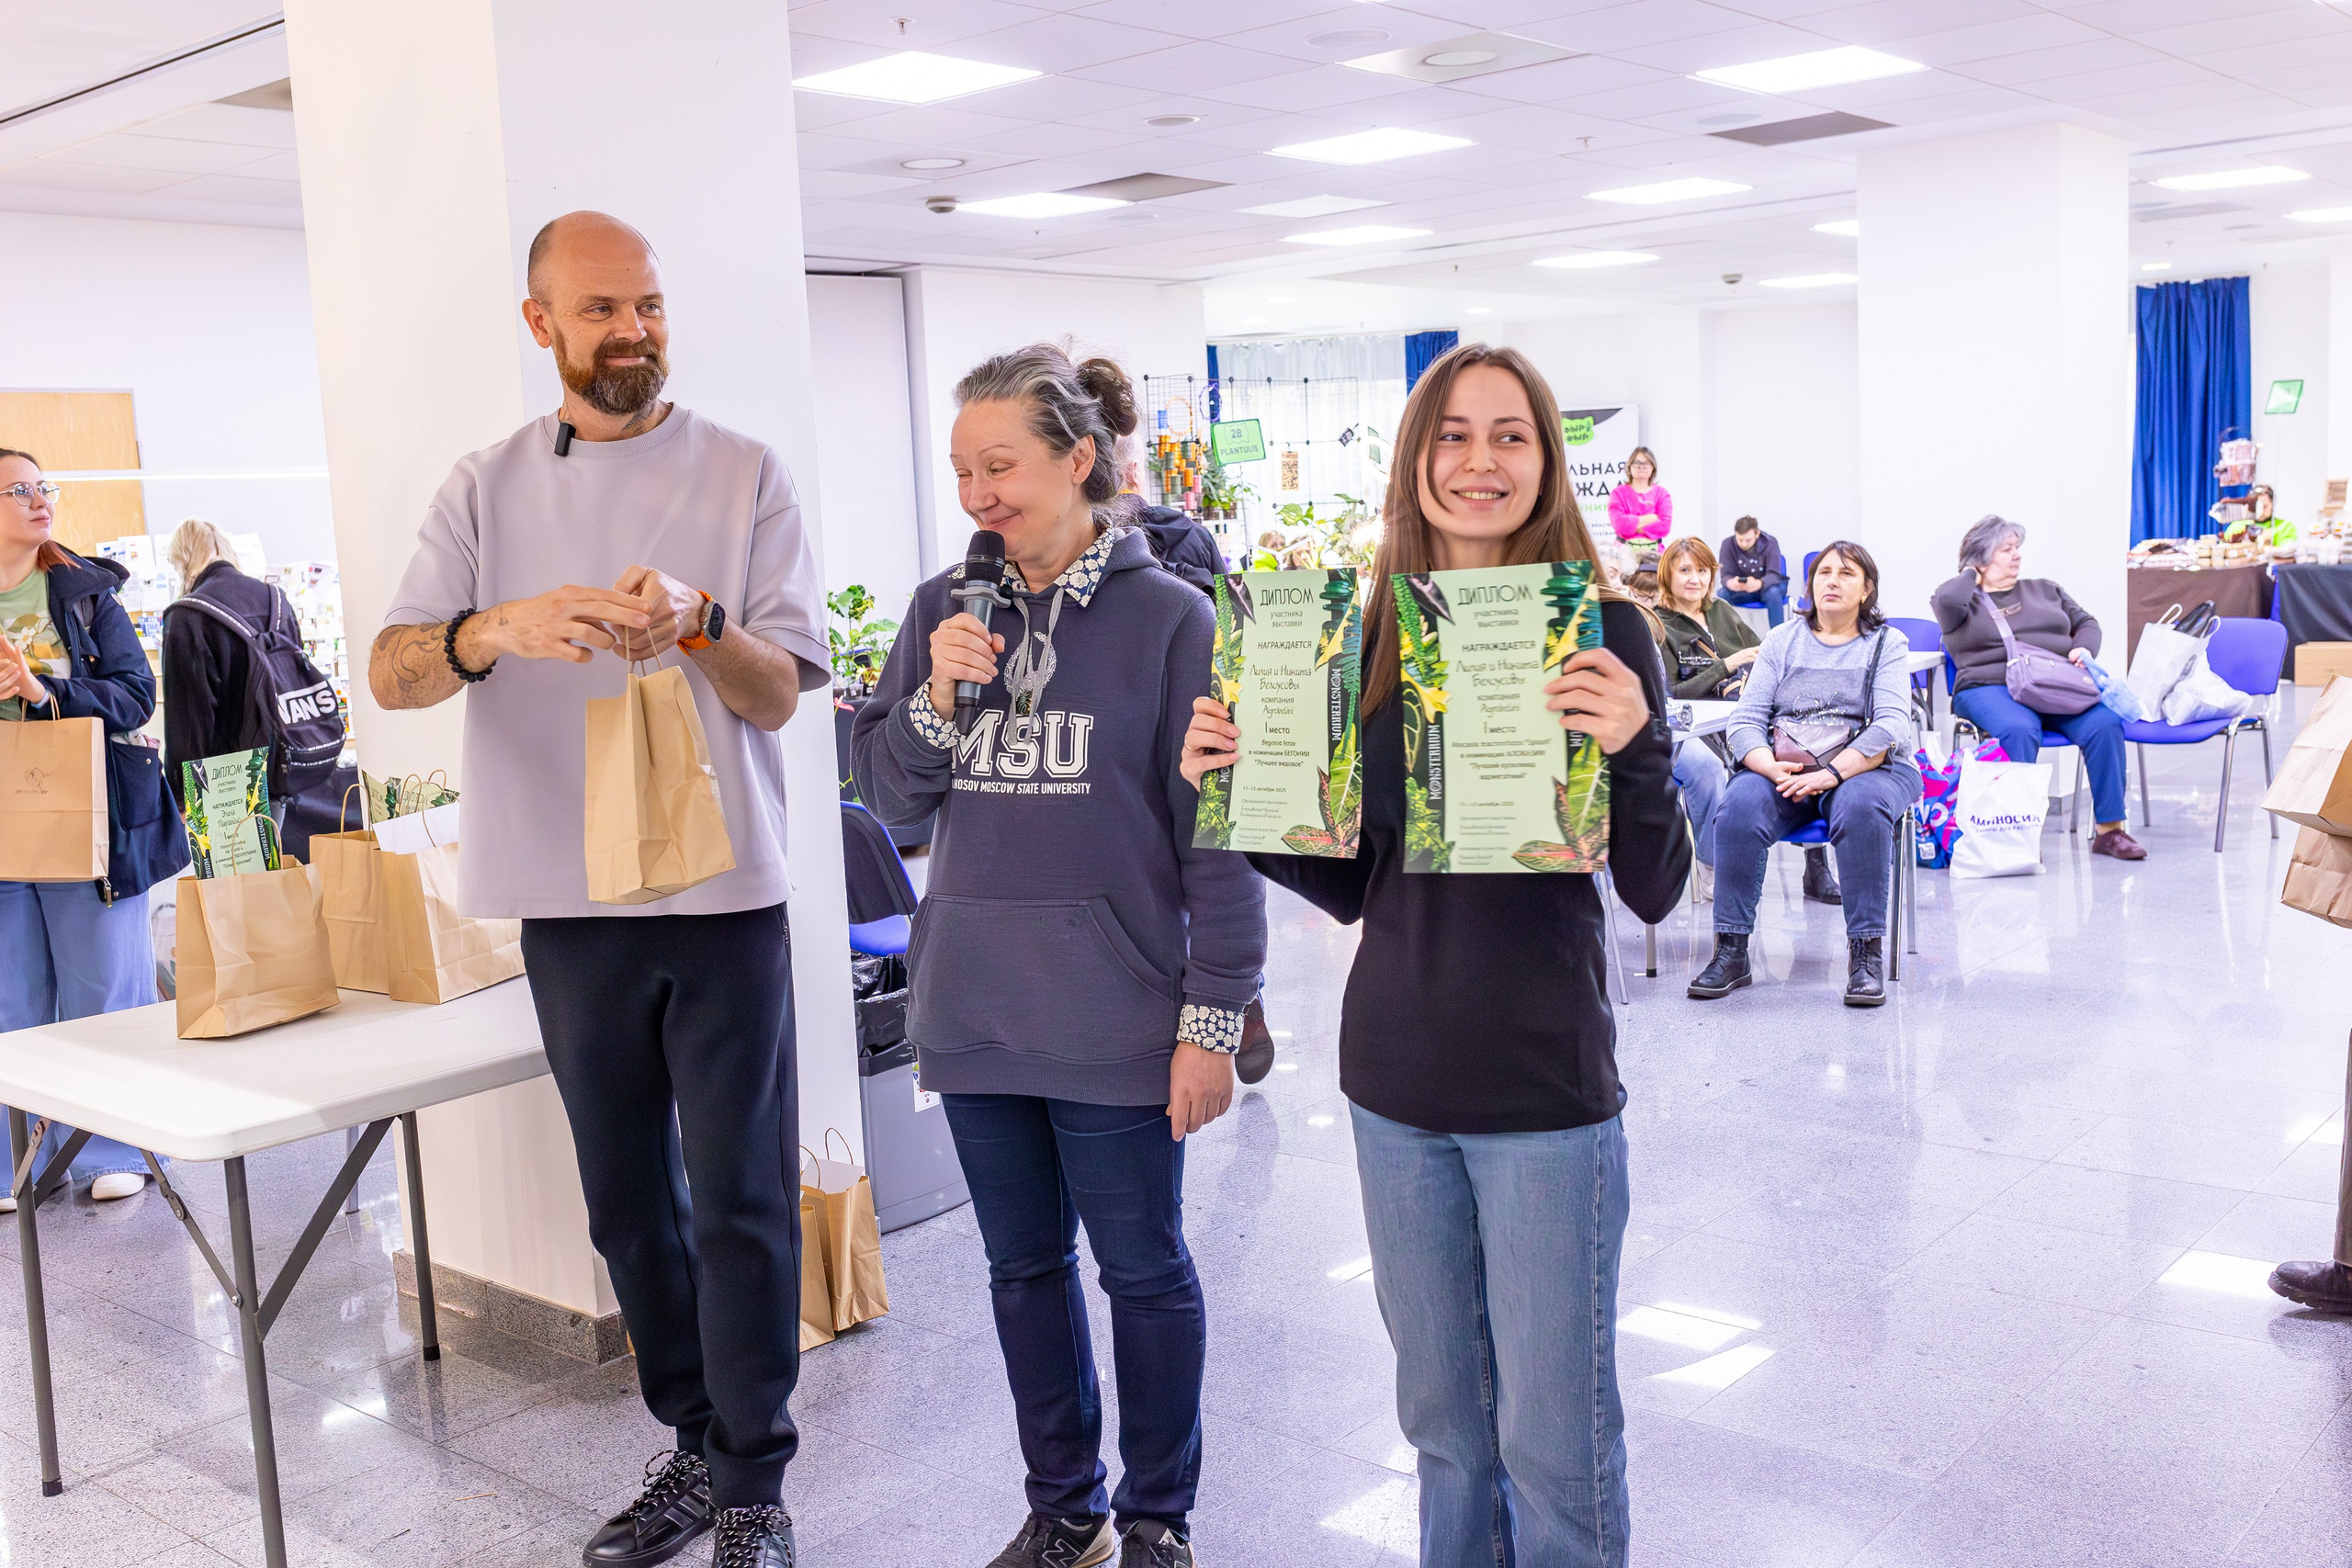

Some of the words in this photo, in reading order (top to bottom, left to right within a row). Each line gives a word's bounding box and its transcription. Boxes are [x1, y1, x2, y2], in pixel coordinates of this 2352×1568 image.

[1231, 428, 1242, 439] 28
[1220, 445, 1259, 457] PLANTULIS
[1260, 587, 1314, 606] ДИПЛОМ
[1457, 584, 1533, 605] ДИПЛОМ
[1271, 610, 1303, 620] участника
[1272, 620, 1303, 628] выставки
[1257, 640, 1312, 650] НАГРАЖДАЕТСЯ
[1462, 640, 1536, 652] НАГРАЖДАЕТСЯ
[1250, 664, 1272, 677] Лилия
[1273, 668, 1279, 676] и
[1280, 664, 1312, 677] Никита
[1260, 677, 1300, 696] Белоусовы
[276, 680, 336, 725] VANS
[1261, 696, 1295, 705] компания
[1331, 668, 1342, 741] MONSTERRIUM
[952, 709, 1093, 778] MSU
[1427, 724, 1442, 801] MONSTERRIUM
[211, 764, 243, 781] ДИПЛОМ
[980, 781, 1015, 794] MOSCOW
[1016, 783, 1039, 795] STATE
[1041, 783, 1091, 795] UNIVERSITY
[212, 798, 243, 810] НАГРАЖДАЕТСЯ
